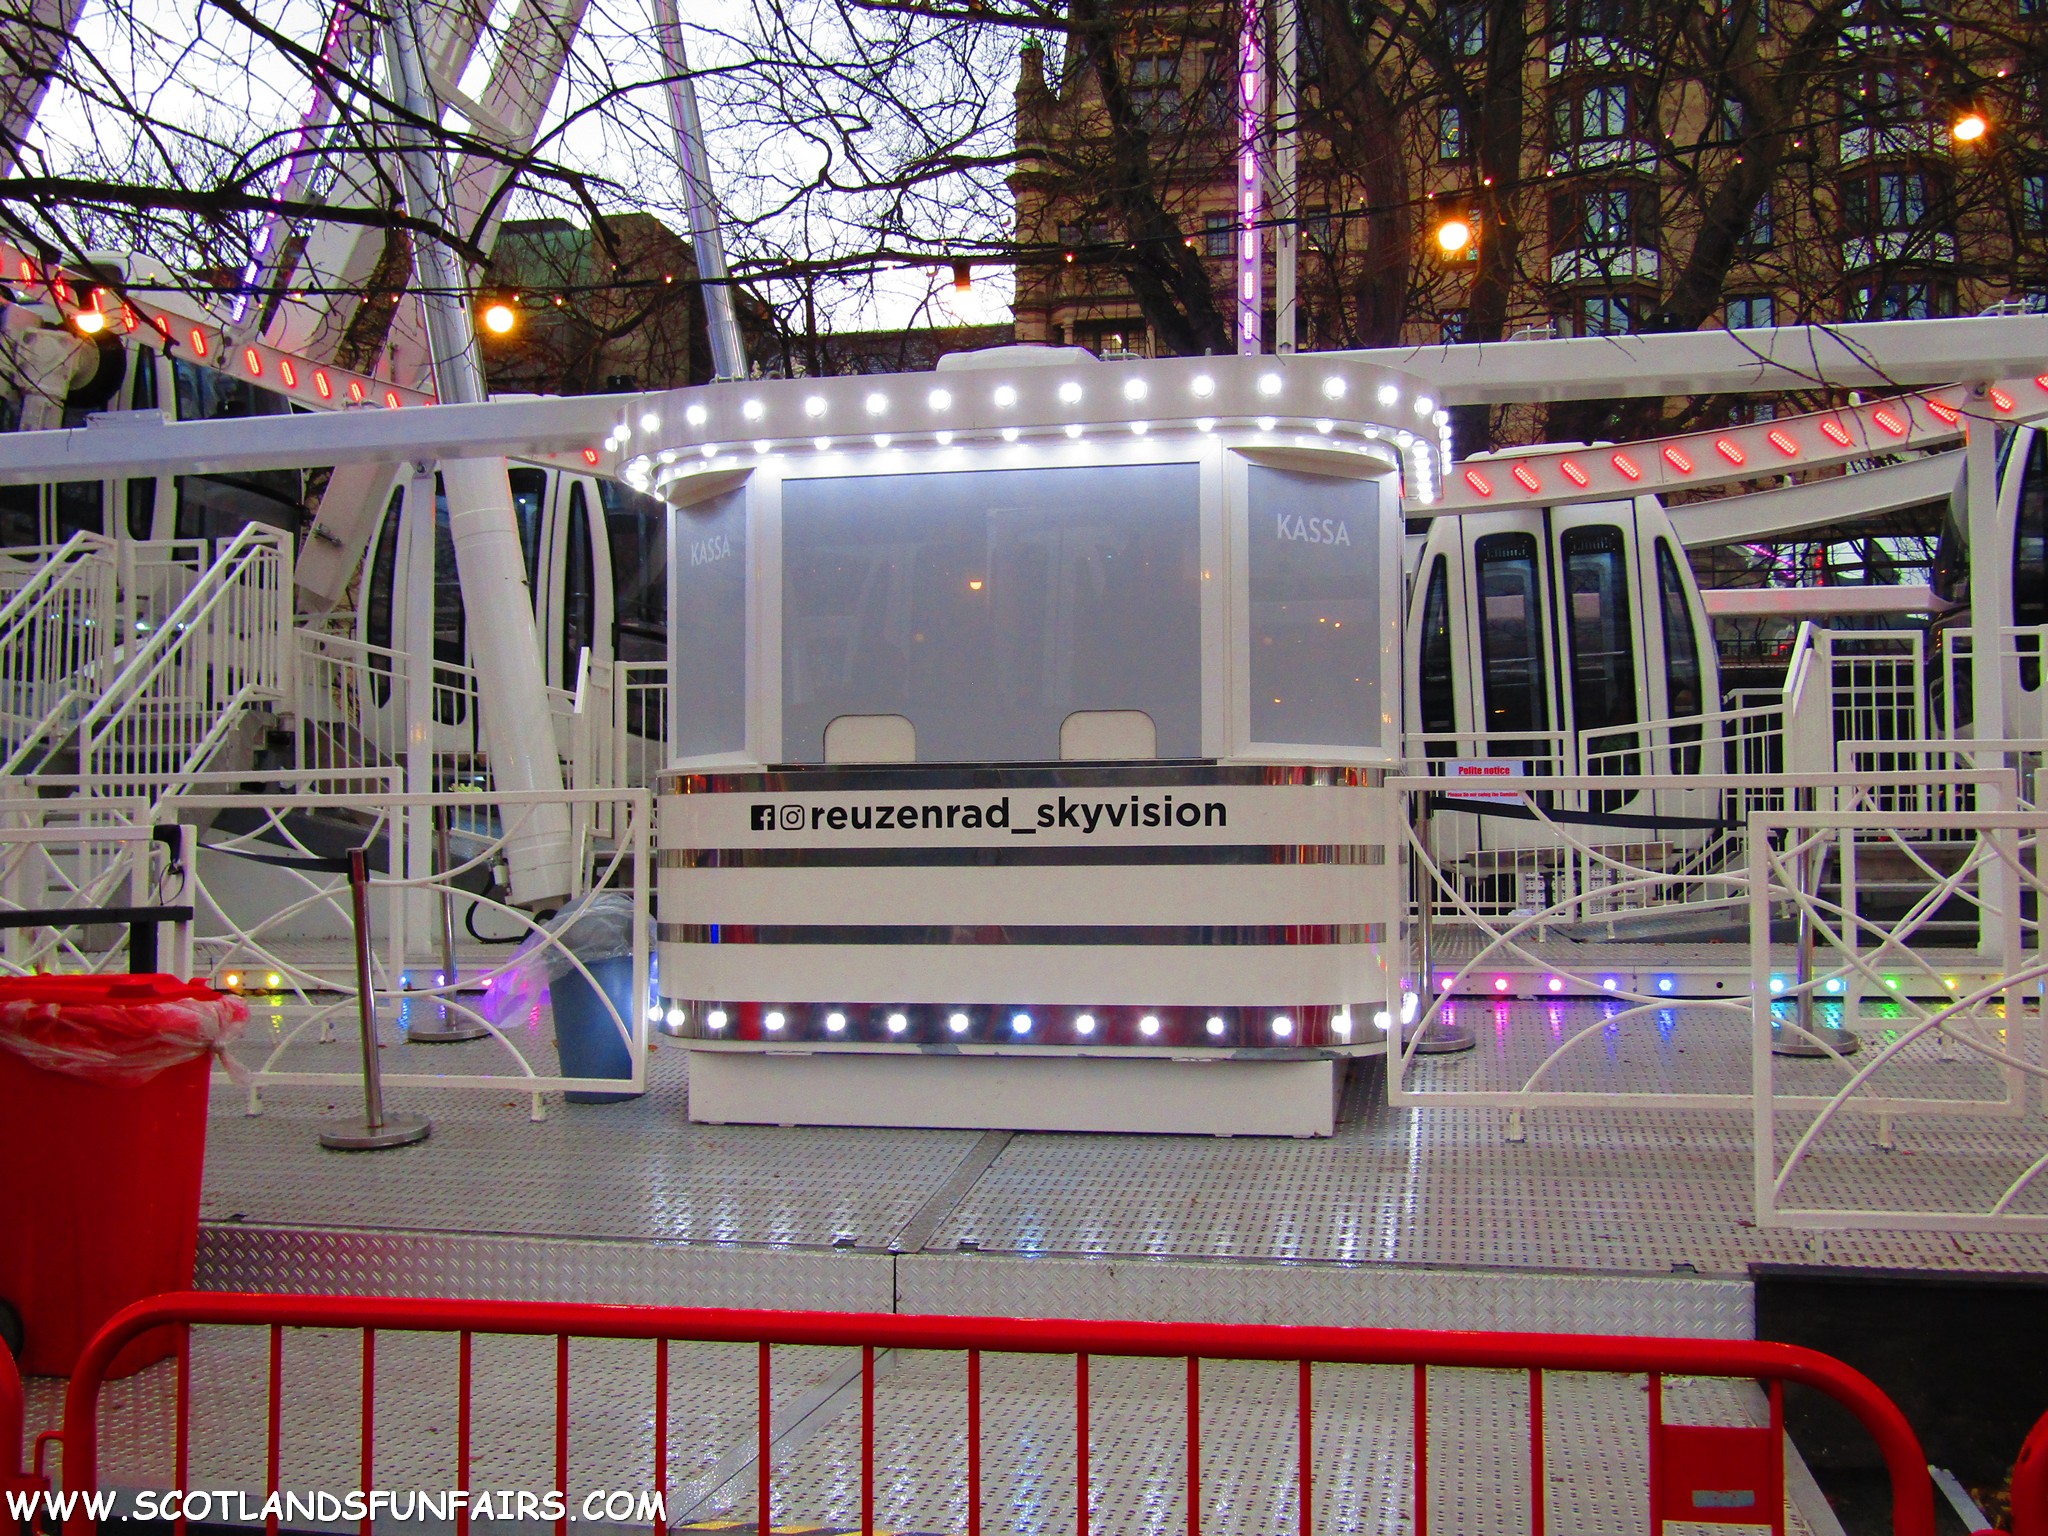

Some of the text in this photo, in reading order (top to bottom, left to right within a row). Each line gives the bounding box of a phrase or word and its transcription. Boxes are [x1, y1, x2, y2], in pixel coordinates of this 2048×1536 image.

[1277, 513, 1351, 547] KASSA
[691, 533, 731, 567] KASSA
[1458, 766, 1510, 775] Polite notice
[811, 795, 1227, 834] reuzenrad_skyvision
